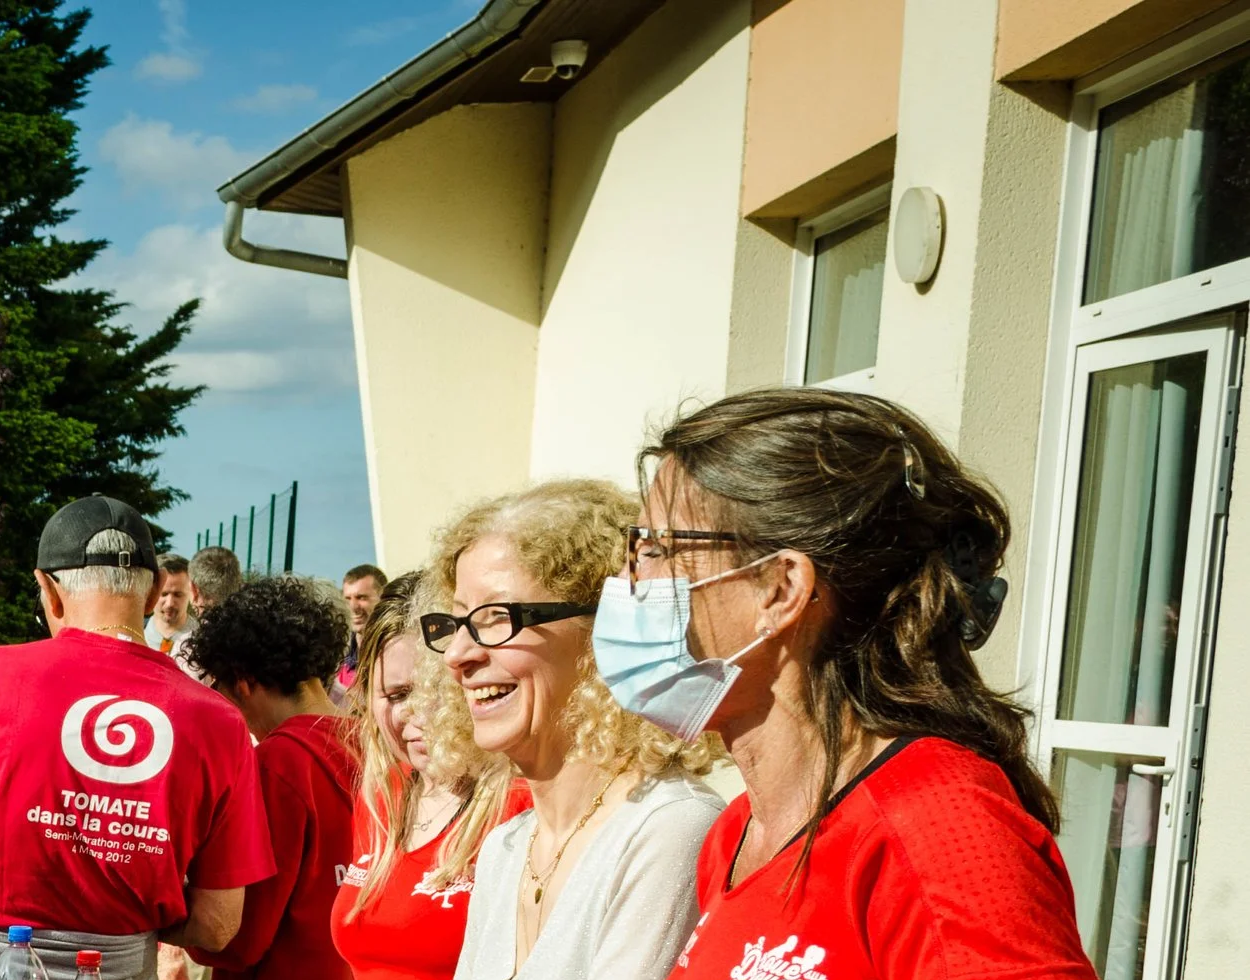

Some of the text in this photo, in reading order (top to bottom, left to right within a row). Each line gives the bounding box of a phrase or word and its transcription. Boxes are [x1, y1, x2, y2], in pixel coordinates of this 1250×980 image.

[61, 789, 151, 820] TOMATE
[27, 806, 170, 842] dans la cours
[45, 828, 164, 855] Semi-Marathon de Paris
[71, 845, 132, 864] 4 Mars 2012
